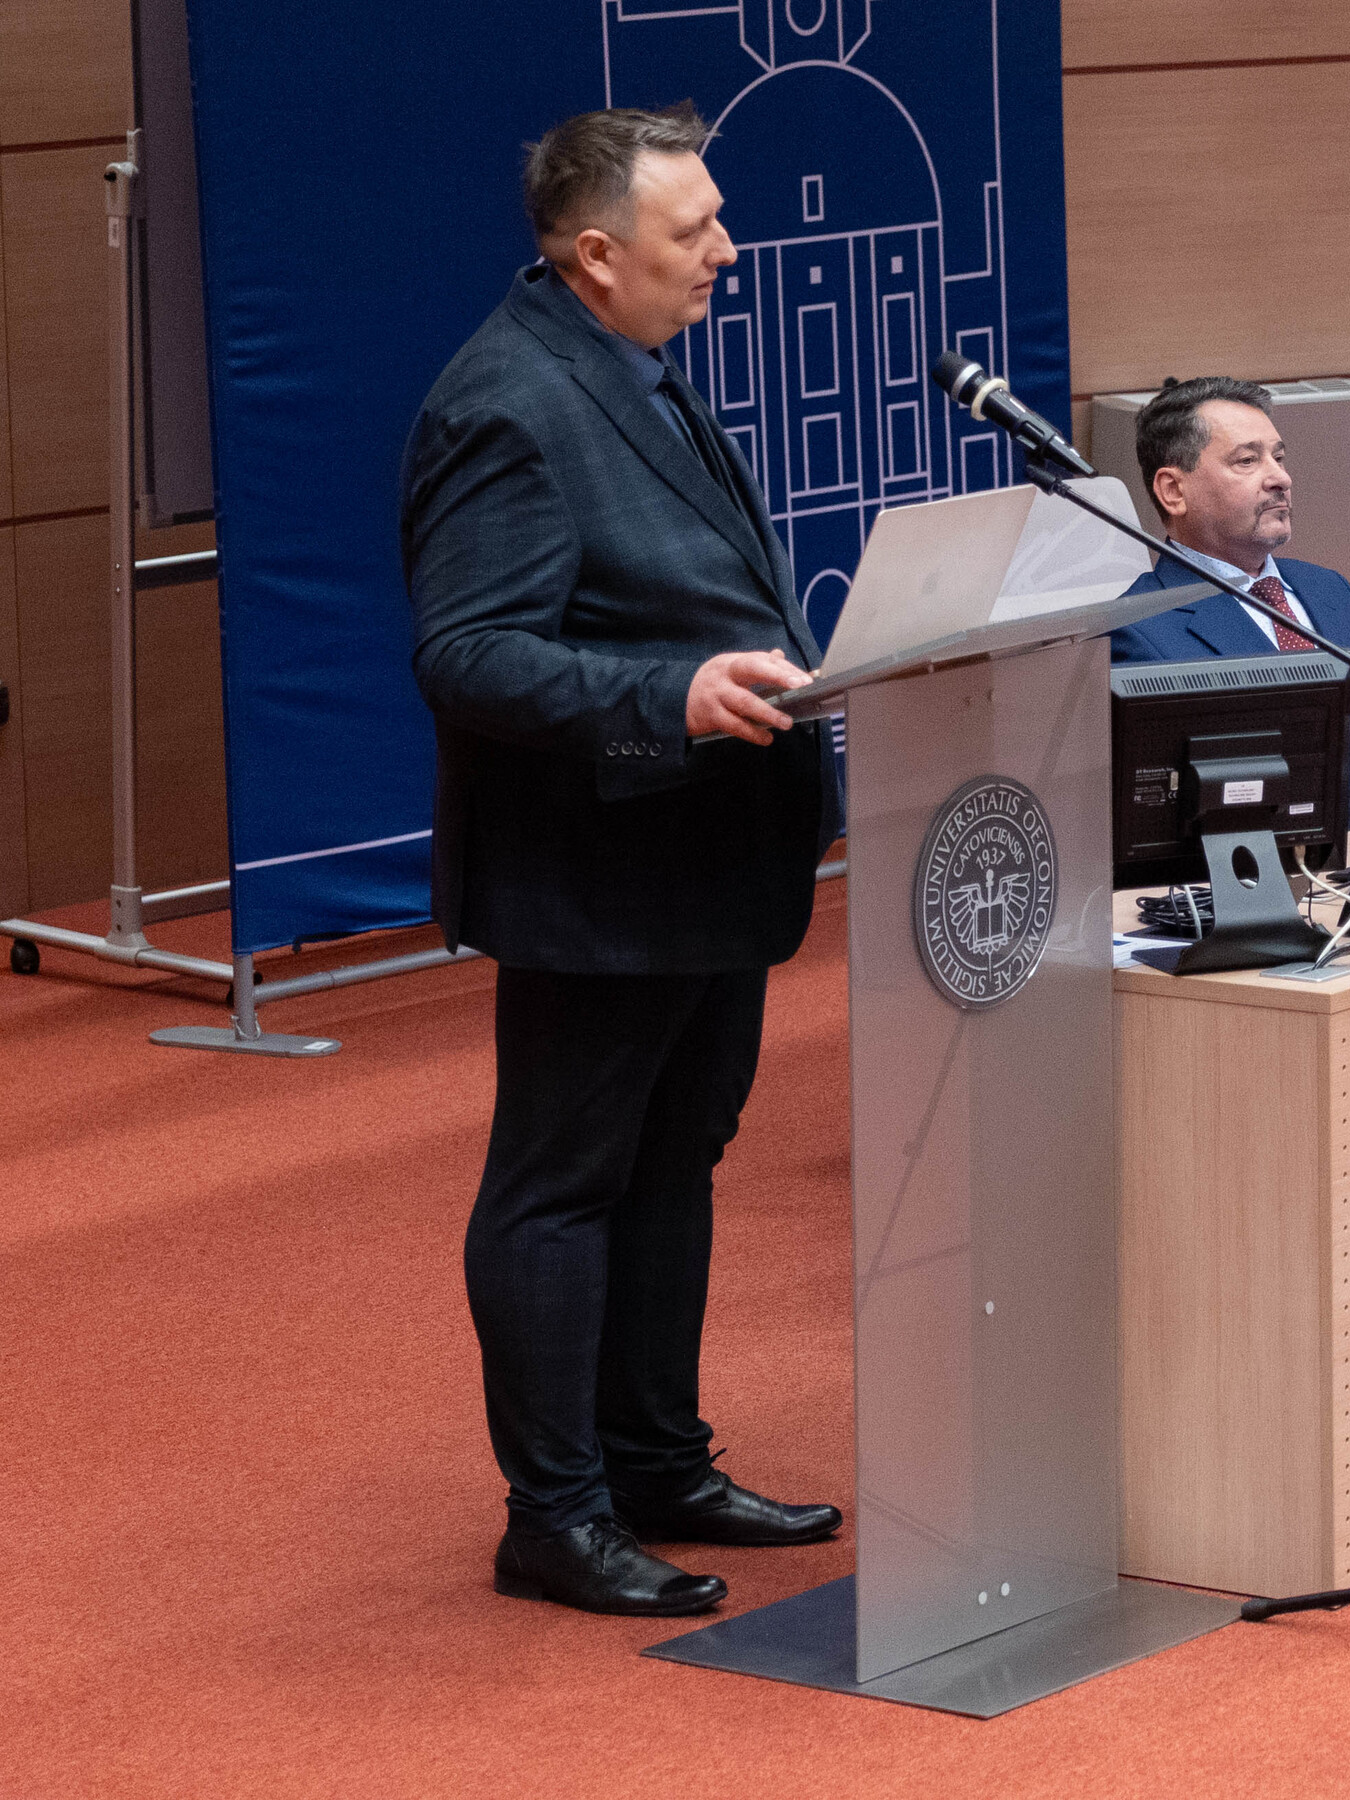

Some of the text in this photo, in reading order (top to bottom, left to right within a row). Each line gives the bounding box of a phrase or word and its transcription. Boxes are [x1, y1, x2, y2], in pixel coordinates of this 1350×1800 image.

[927, 791, 1020, 906] UNIVERSITATIS
[953, 826, 1026, 878] CATOVICIENSIS
[975, 847, 1006, 871] 1937
[994, 810, 1051, 992] OECONOMICAE
[928, 917, 986, 995] SIGILLUM
